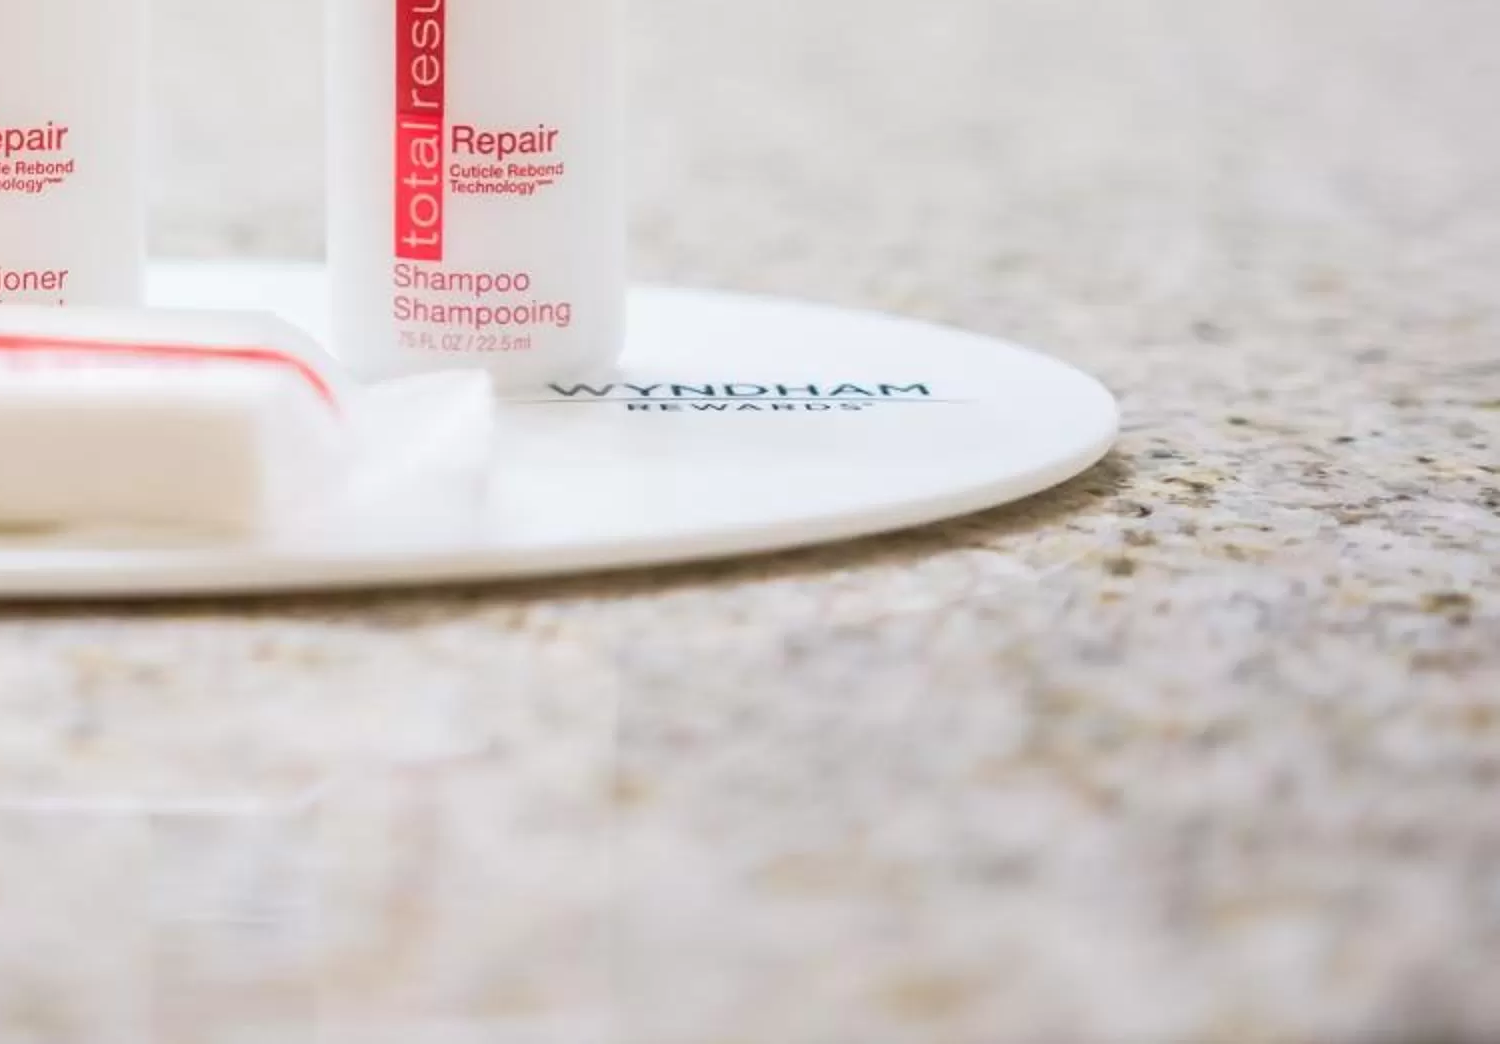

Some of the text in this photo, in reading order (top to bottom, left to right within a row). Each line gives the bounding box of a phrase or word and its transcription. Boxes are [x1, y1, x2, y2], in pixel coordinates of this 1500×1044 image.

[451, 123, 559, 161] Repair
[15, 159, 75, 175] Rebond
[449, 162, 565, 179] Cuticle Rebond
[401, 120, 439, 248] total
[449, 179, 536, 196] Technology
[393, 263, 531, 297] Shampoo
[393, 295, 573, 331] Shampooing
[441, 333, 463, 352] OZ
[547, 382, 931, 397] WYNDHAM
[626, 402, 864, 412] REWARDS
